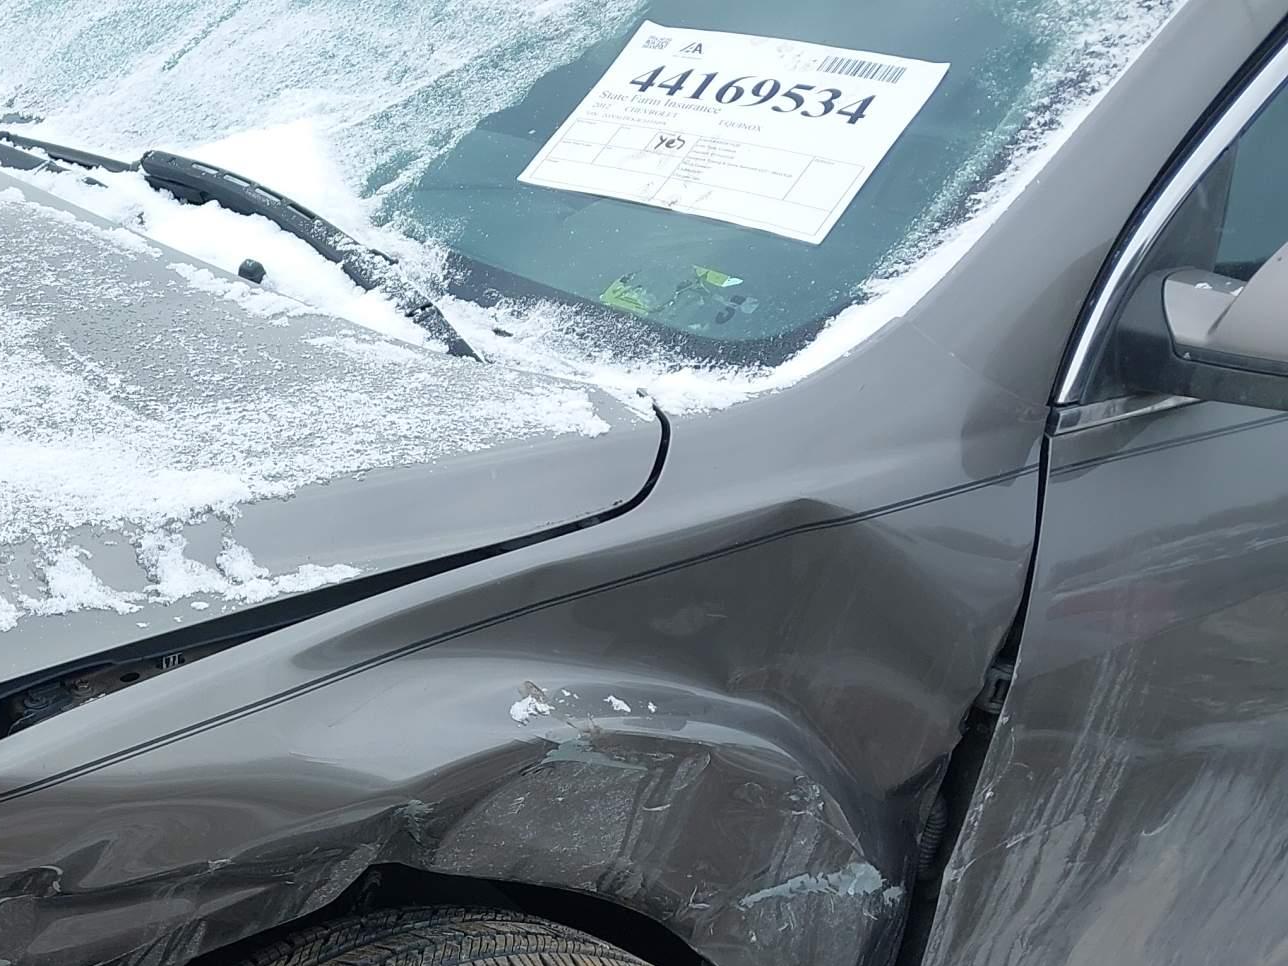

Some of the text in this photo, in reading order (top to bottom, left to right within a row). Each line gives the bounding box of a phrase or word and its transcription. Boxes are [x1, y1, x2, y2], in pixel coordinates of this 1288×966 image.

[598, 89, 722, 115] State Farm Insurance
[629, 65, 876, 125] 44169534
[717, 118, 762, 133] EQUINOX
